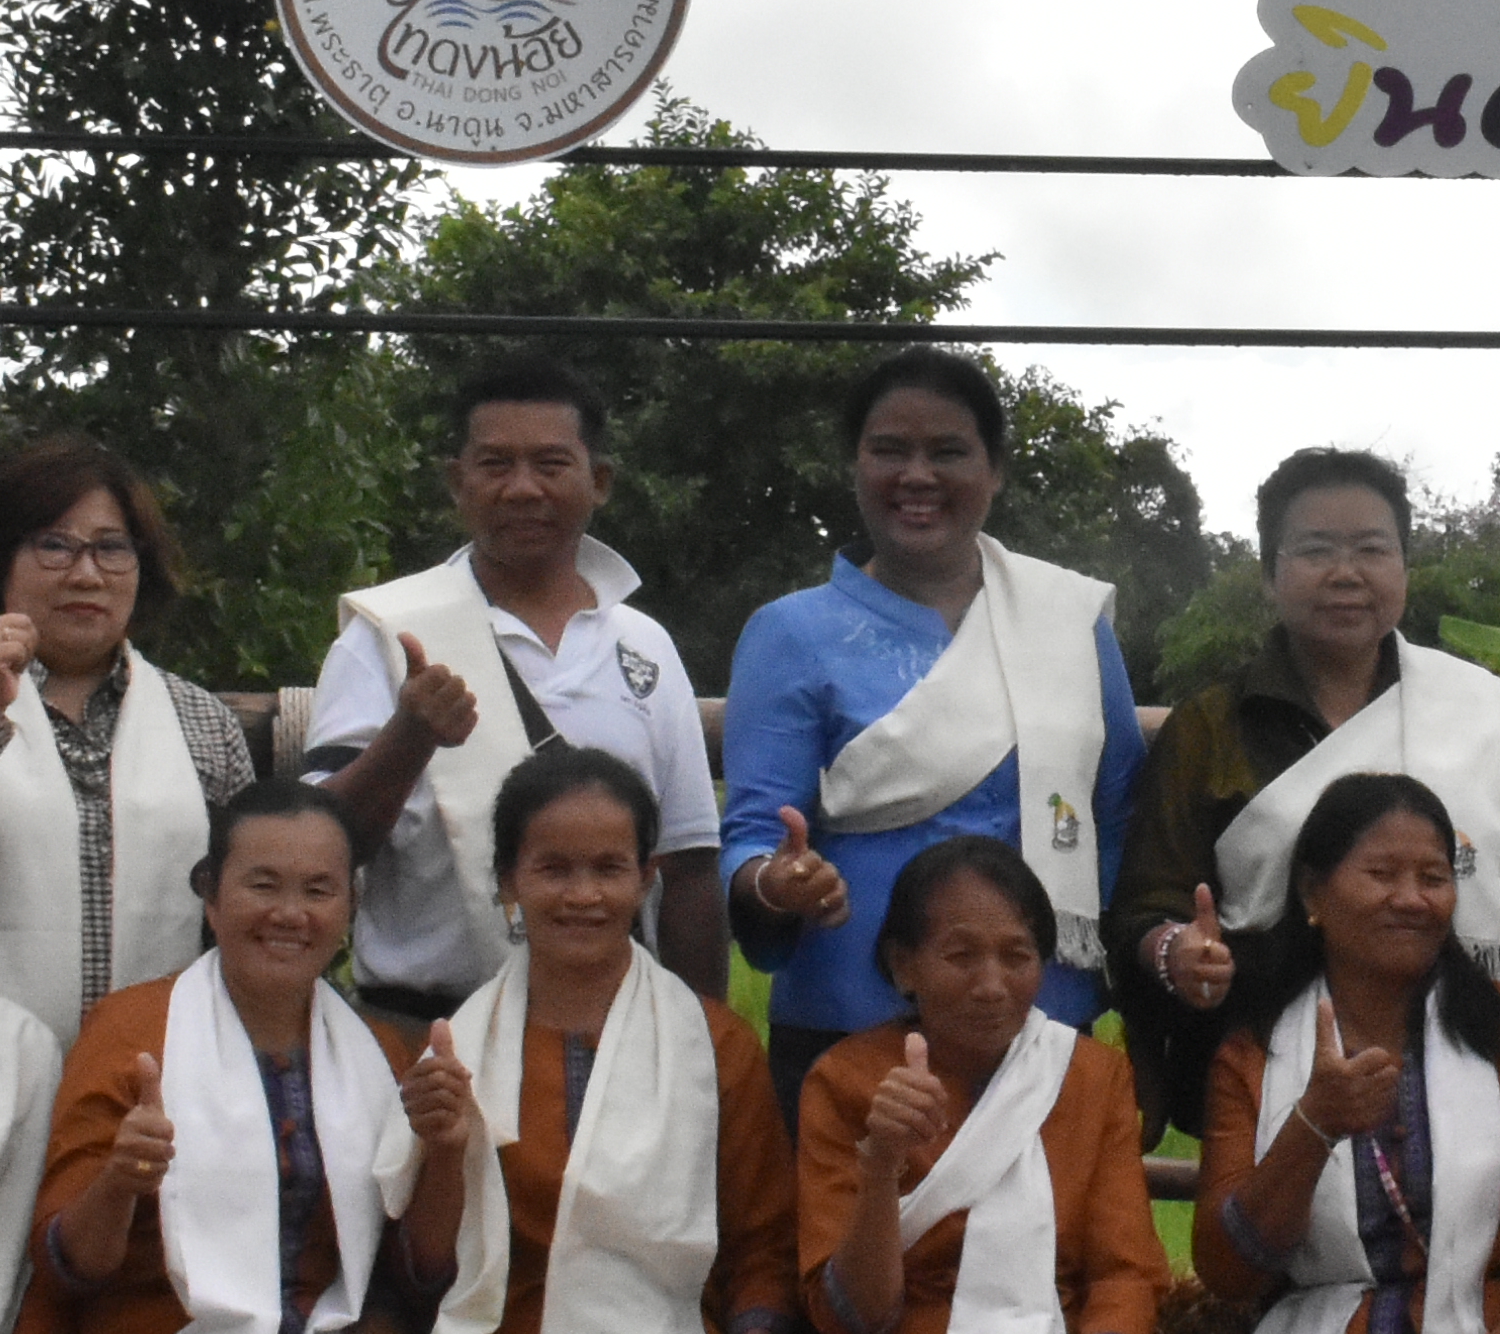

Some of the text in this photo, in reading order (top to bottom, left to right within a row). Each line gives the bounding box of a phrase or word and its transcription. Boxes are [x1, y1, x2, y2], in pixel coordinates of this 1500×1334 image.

[410, 71, 567, 104] THAI DONG NOI
[396, 100, 505, 146] อ.นาดูน
